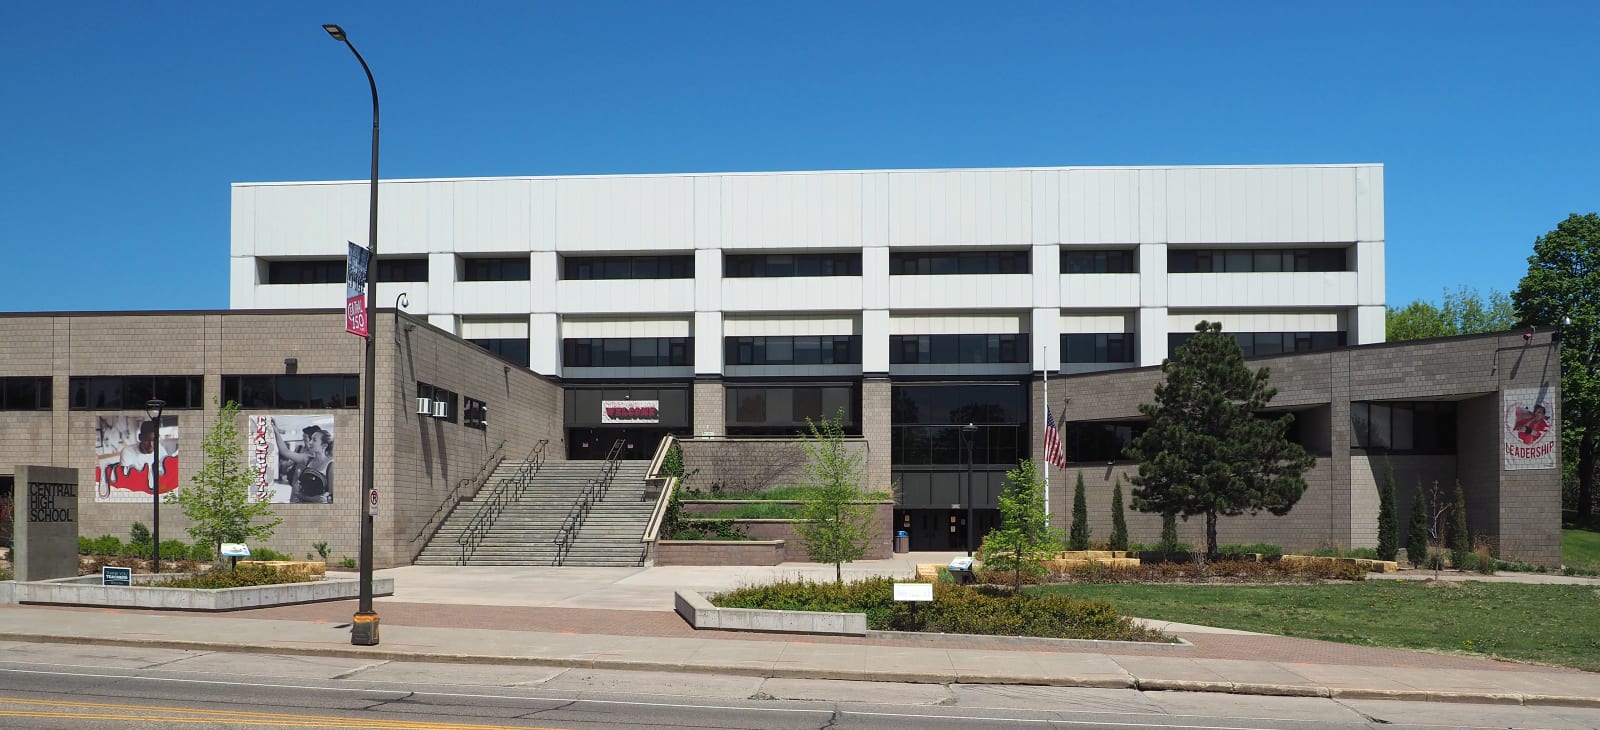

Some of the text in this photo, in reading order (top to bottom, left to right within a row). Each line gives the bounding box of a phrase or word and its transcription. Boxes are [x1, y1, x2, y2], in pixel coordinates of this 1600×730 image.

[352, 314, 364, 330] 150
[606, 407, 658, 419] WELCOME
[1505, 441, 1554, 458] LEADERSHIP
[30, 483, 76, 497] CENTRAL
[31, 496, 54, 509] HIGH
[31, 509, 72, 522] SCHOOL
